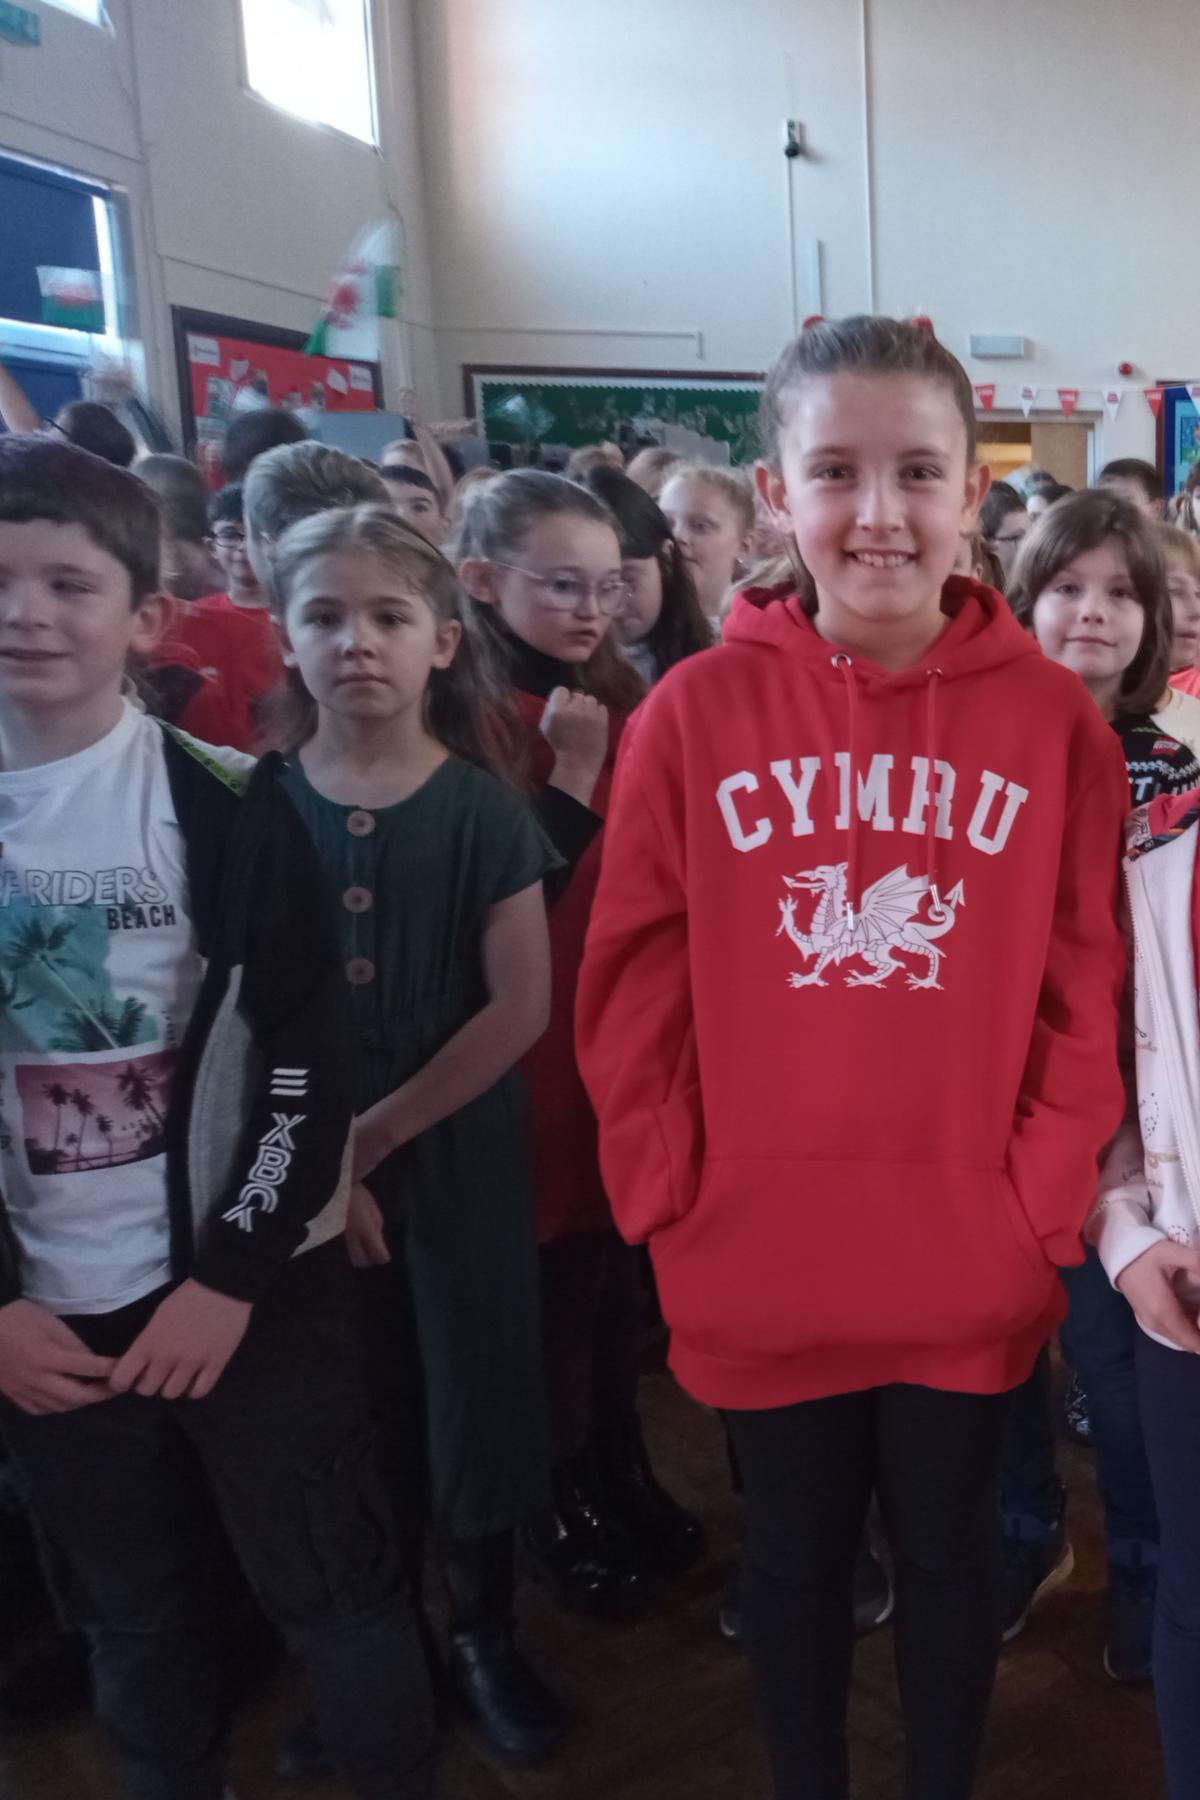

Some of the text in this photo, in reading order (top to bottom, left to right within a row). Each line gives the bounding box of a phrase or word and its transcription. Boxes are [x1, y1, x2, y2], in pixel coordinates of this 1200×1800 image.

[715, 752, 1029, 856] CYMRU
[25, 866, 169, 908] RIDERS
[106, 904, 177, 931] BEACH
